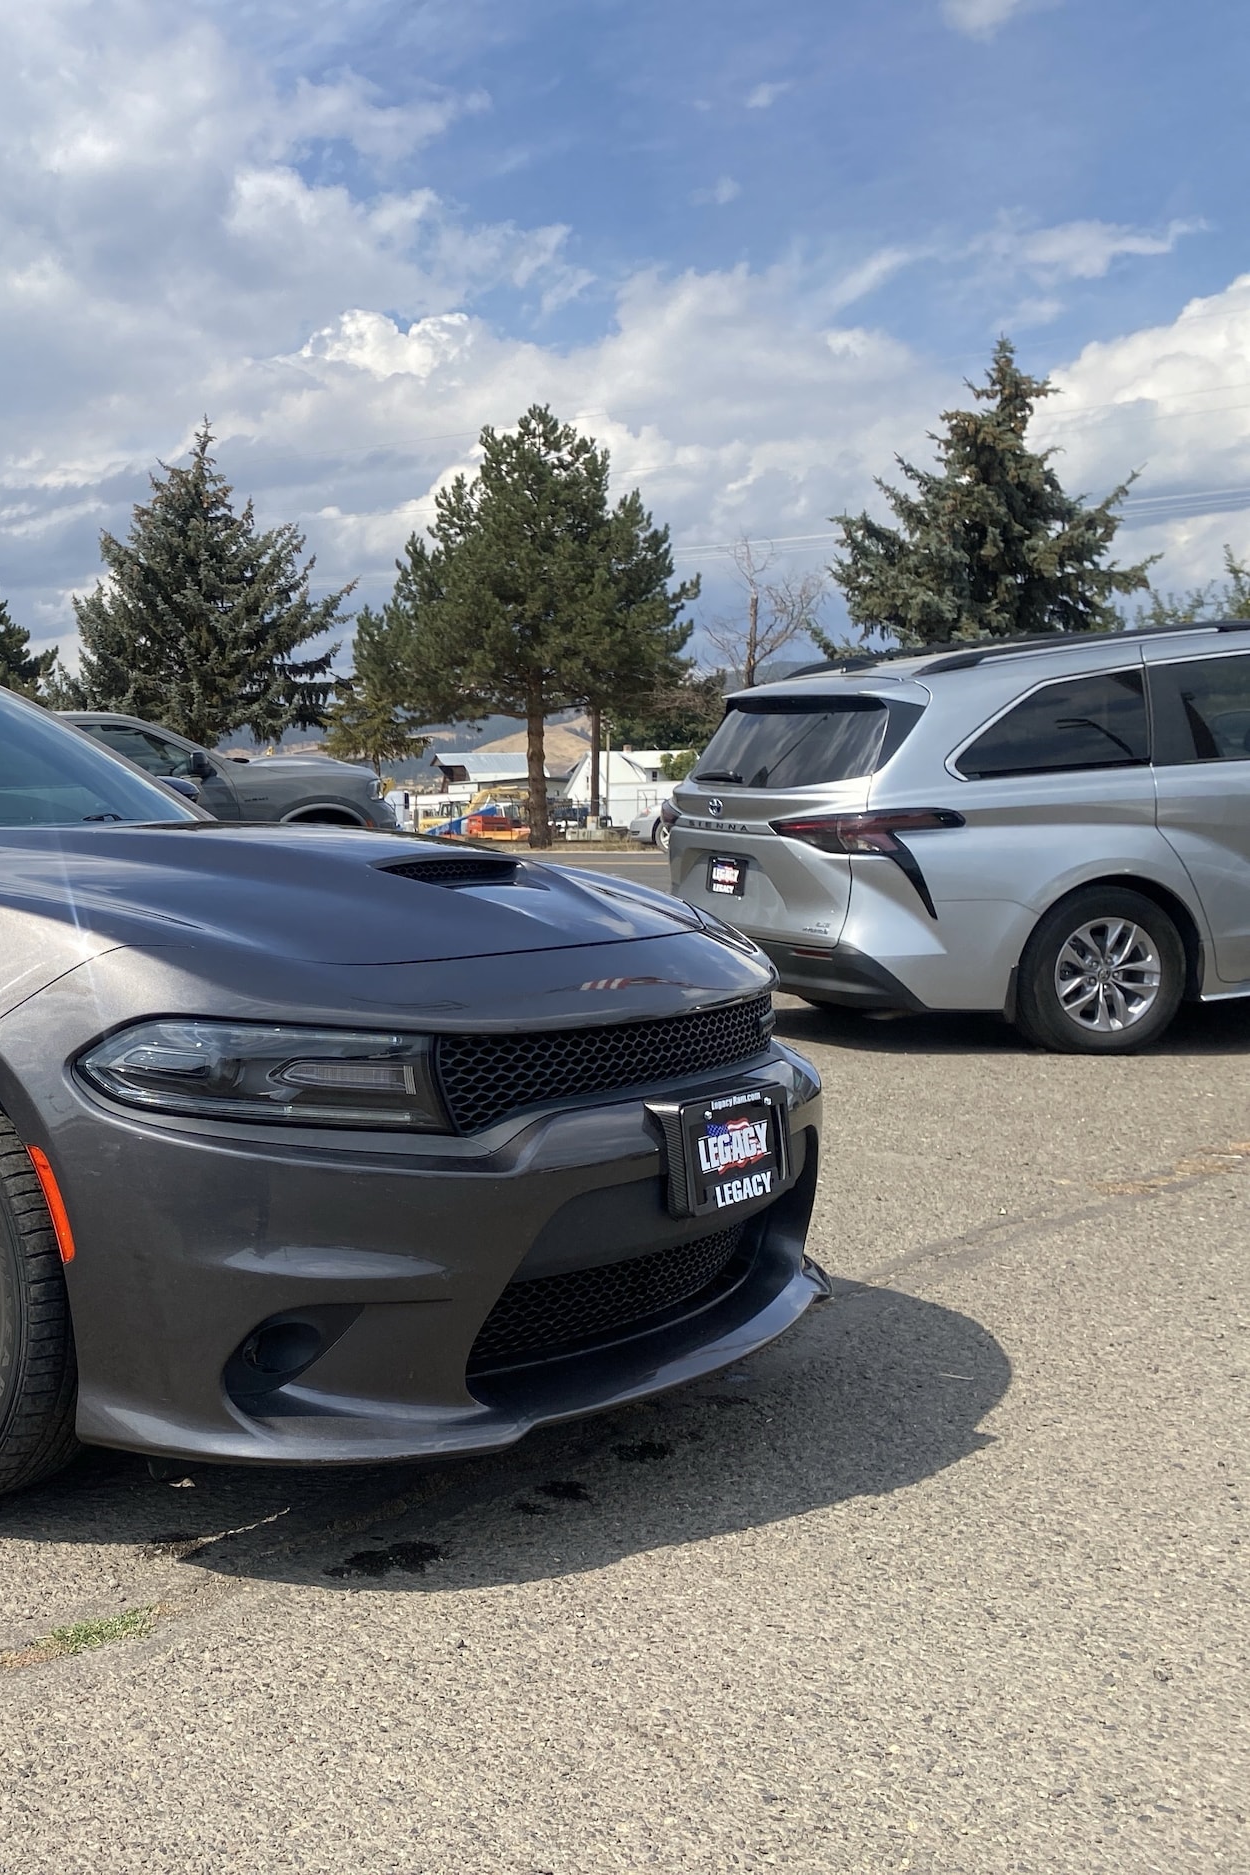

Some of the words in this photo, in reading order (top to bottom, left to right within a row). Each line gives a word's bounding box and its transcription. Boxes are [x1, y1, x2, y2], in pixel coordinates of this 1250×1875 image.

[688, 819, 750, 832] SIENNA
[712, 867, 740, 883] LEGACY
[712, 882, 735, 894] LEGACY
[698, 1122, 768, 1171] LEGACY
[715, 1171, 772, 1208] LEGACY
